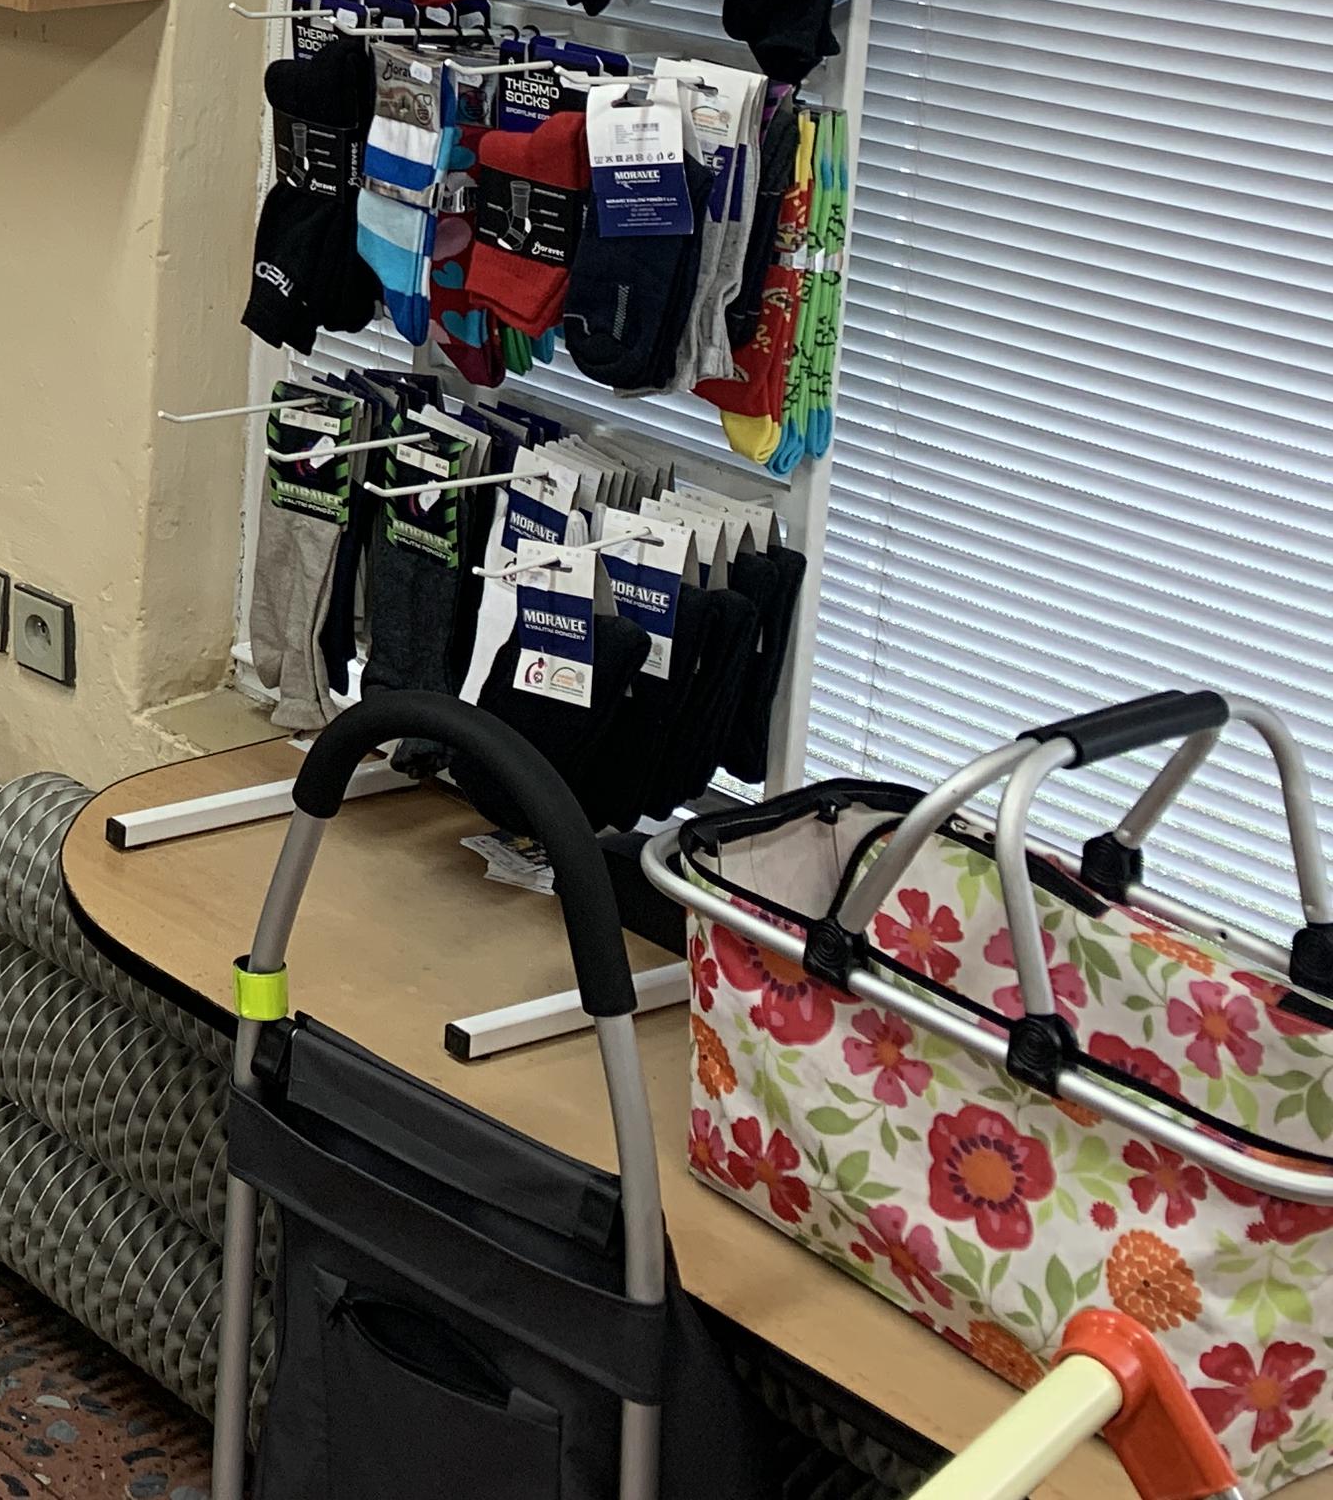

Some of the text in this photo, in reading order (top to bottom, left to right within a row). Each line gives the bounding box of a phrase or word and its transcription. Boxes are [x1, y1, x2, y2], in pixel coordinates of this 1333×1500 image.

[504, 76, 561, 100] THERMO
[505, 90, 551, 111] SOCKS
[613, 169, 661, 181] MORAVEC
[531, 240, 566, 259] Moravec
[509, 511, 561, 545] MORAVEC
[522, 607, 587, 634] MORAVEC
